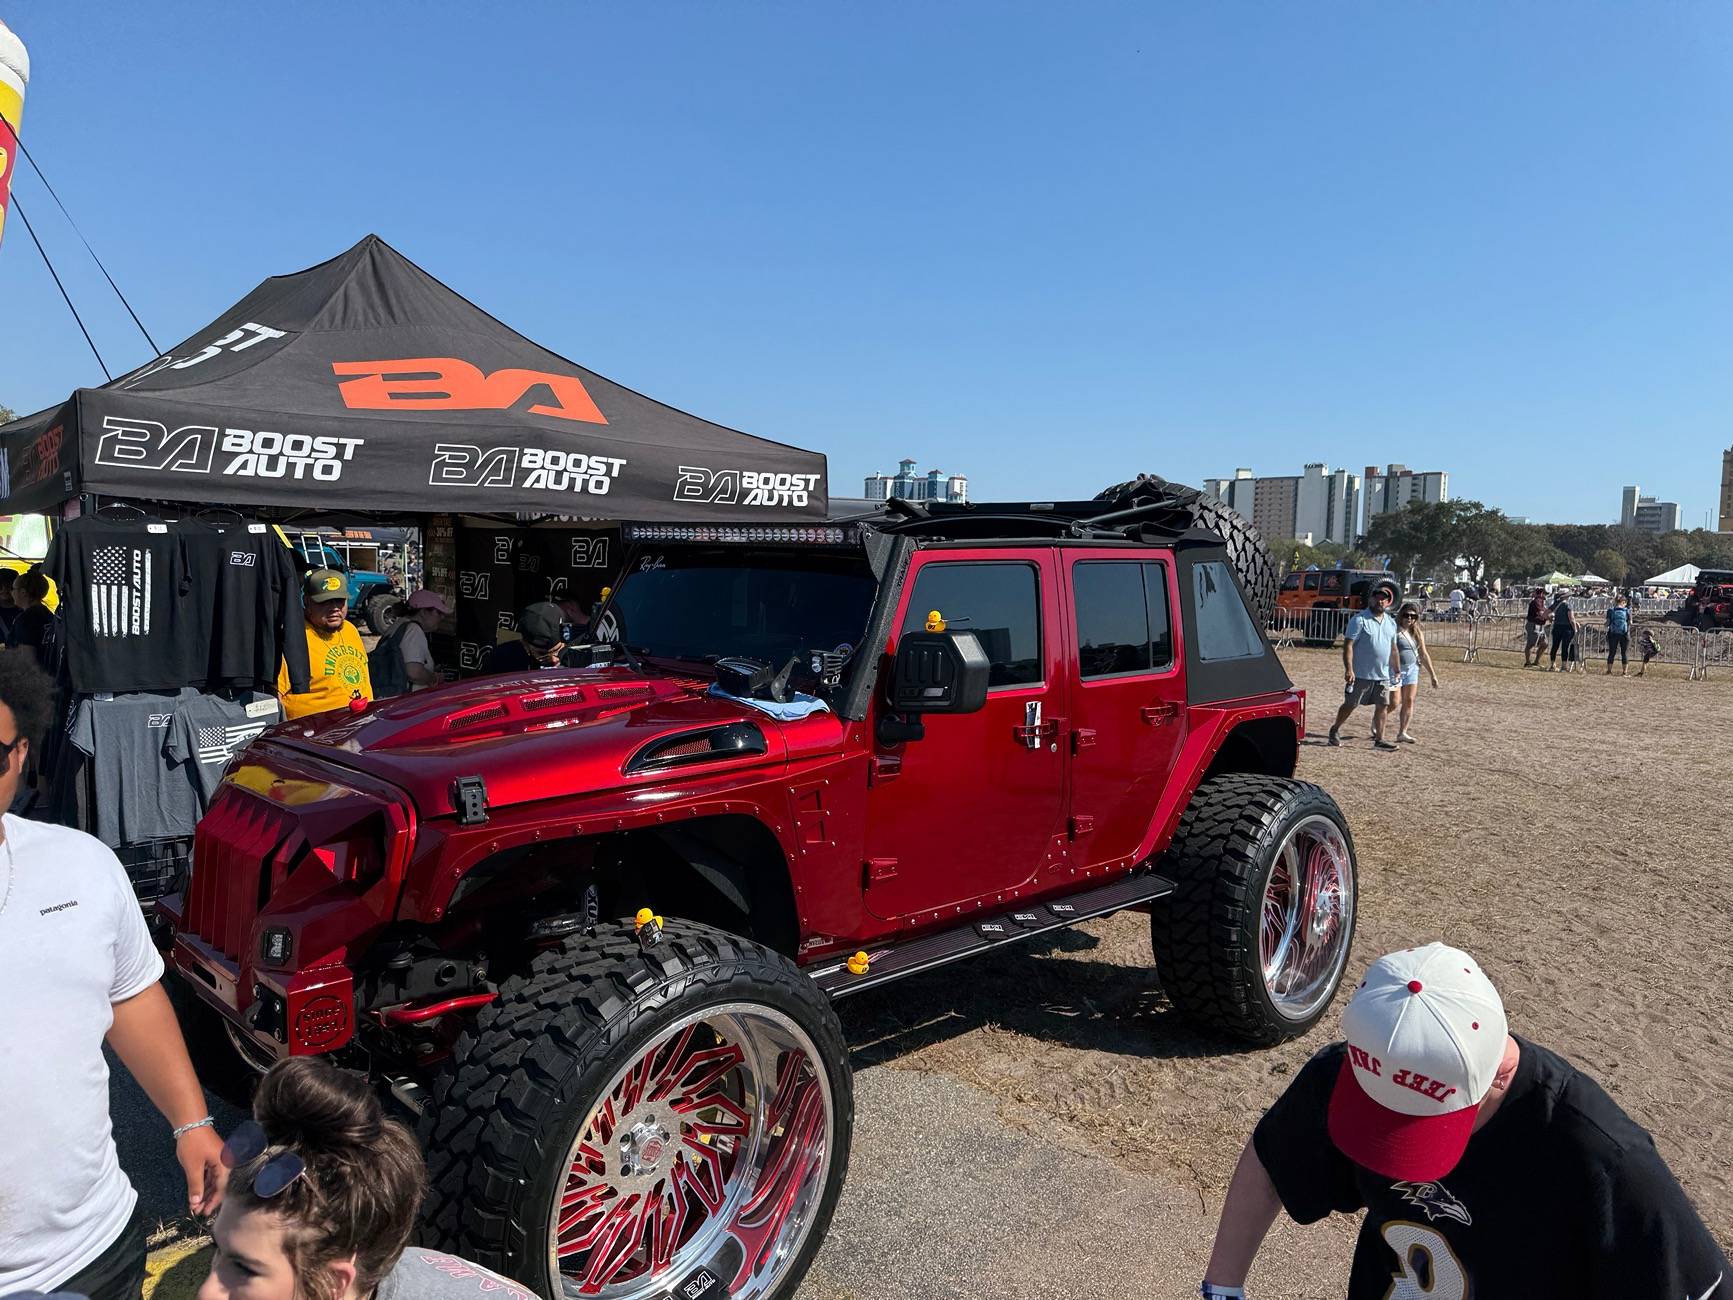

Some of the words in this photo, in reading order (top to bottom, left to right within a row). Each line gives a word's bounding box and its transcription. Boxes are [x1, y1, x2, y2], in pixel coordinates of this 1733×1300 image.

[95, 416, 219, 474] BA
[222, 428, 365, 461] BOOST
[222, 454, 343, 482] AUTO
[429, 443, 520, 487] BA
[521, 448, 627, 477] BOOST
[522, 469, 611, 495] AUTO
[673, 465, 740, 504] BA
[742, 471, 821, 491] BOOST
[742, 489, 809, 507] AUTO
[40, 900, 78, 916] patagonia
[1393, 1069, 1456, 1103] JEEP
